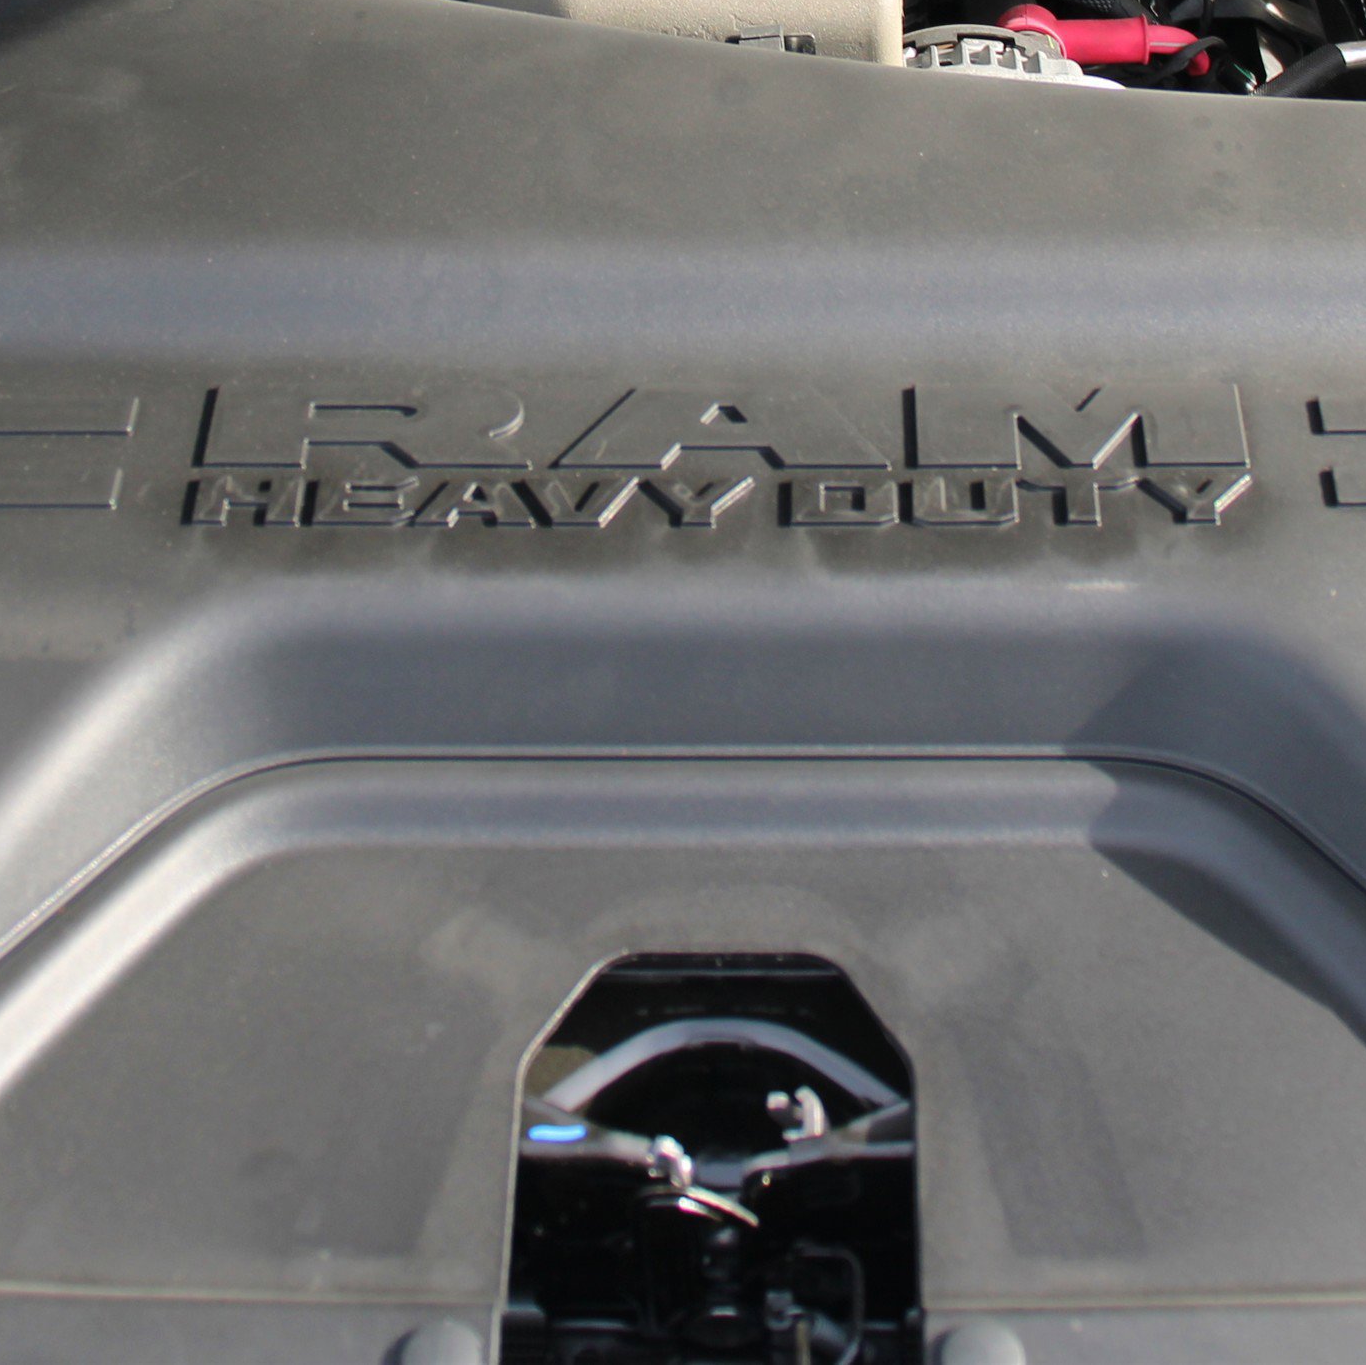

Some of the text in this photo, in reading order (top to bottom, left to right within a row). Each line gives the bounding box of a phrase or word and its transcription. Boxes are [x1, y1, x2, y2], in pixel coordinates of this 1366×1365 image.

[190, 383, 1252, 471] RAM
[179, 474, 1253, 530] HEAVY DUTY
